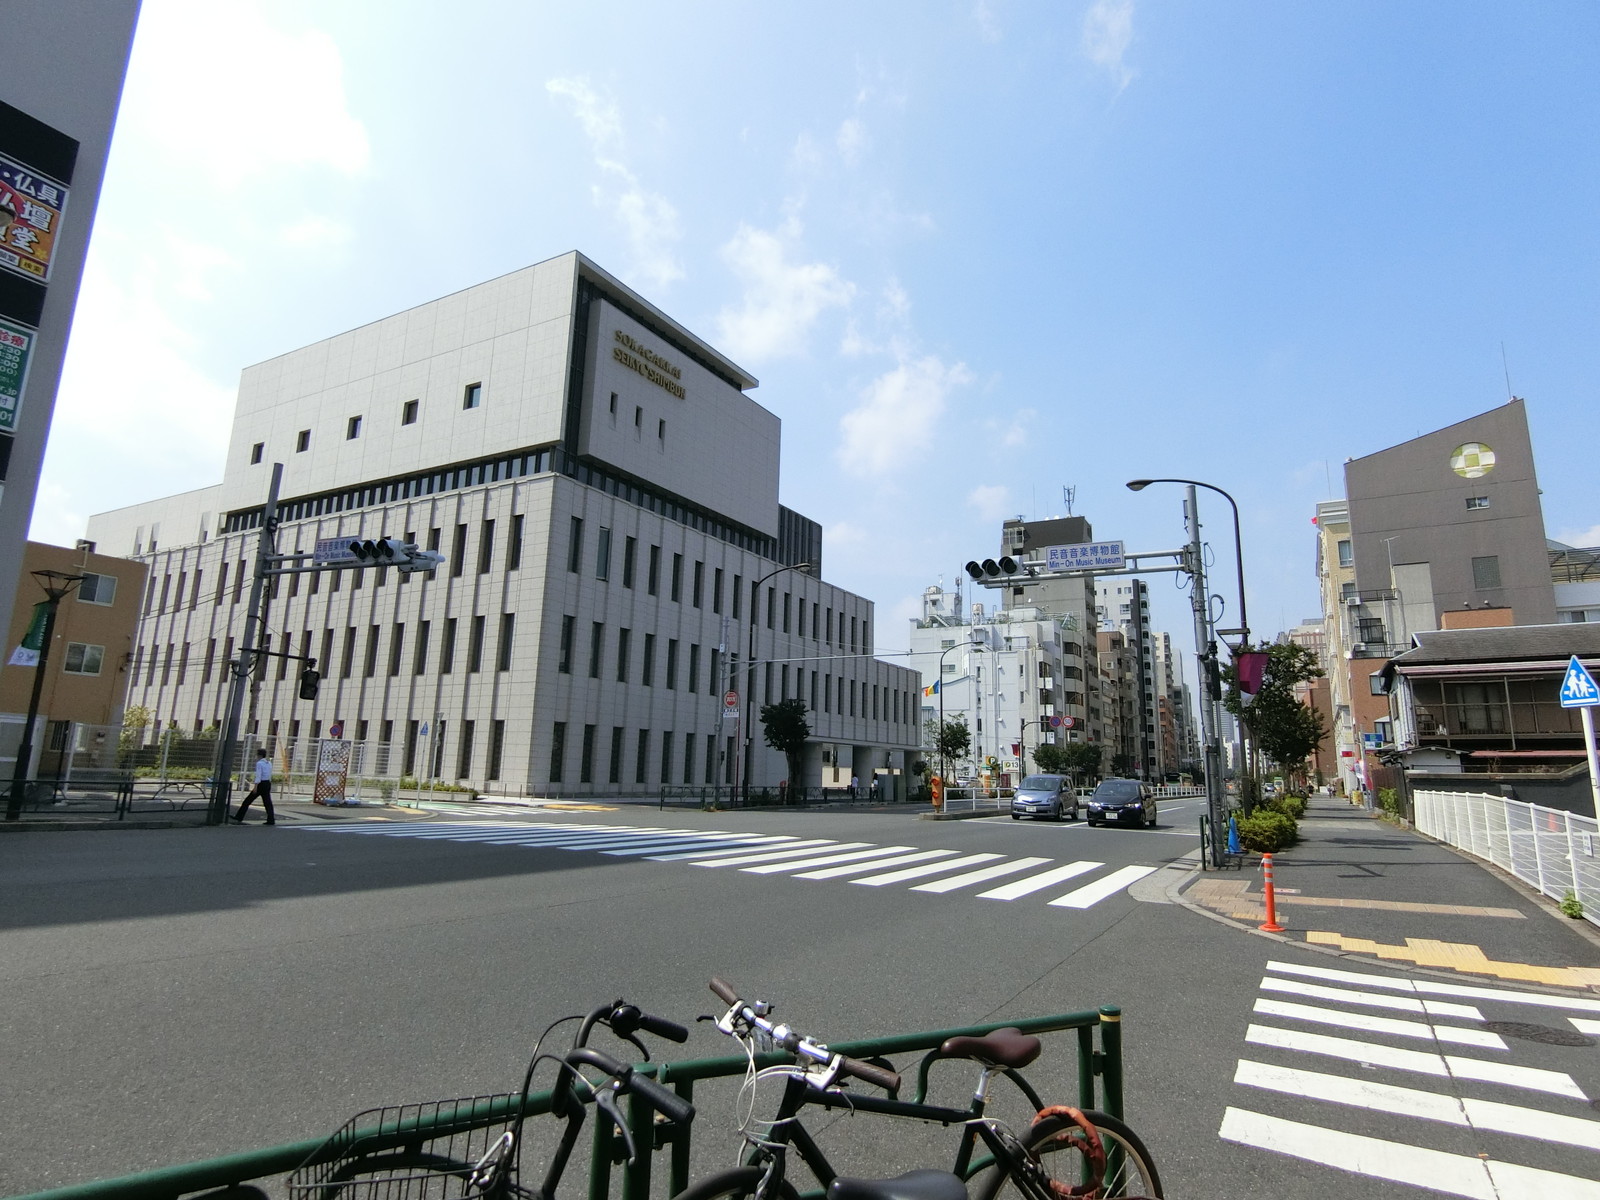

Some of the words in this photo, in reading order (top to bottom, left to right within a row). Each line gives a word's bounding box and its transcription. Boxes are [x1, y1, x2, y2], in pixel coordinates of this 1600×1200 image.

[0, 164, 59, 207] ・仏具
[1049, 544, 1120, 560] 民音音楽博物館
[1049, 560, 1074, 568] Min-On
[1076, 558, 1094, 566] Music
[1096, 556, 1121, 564] Museum
